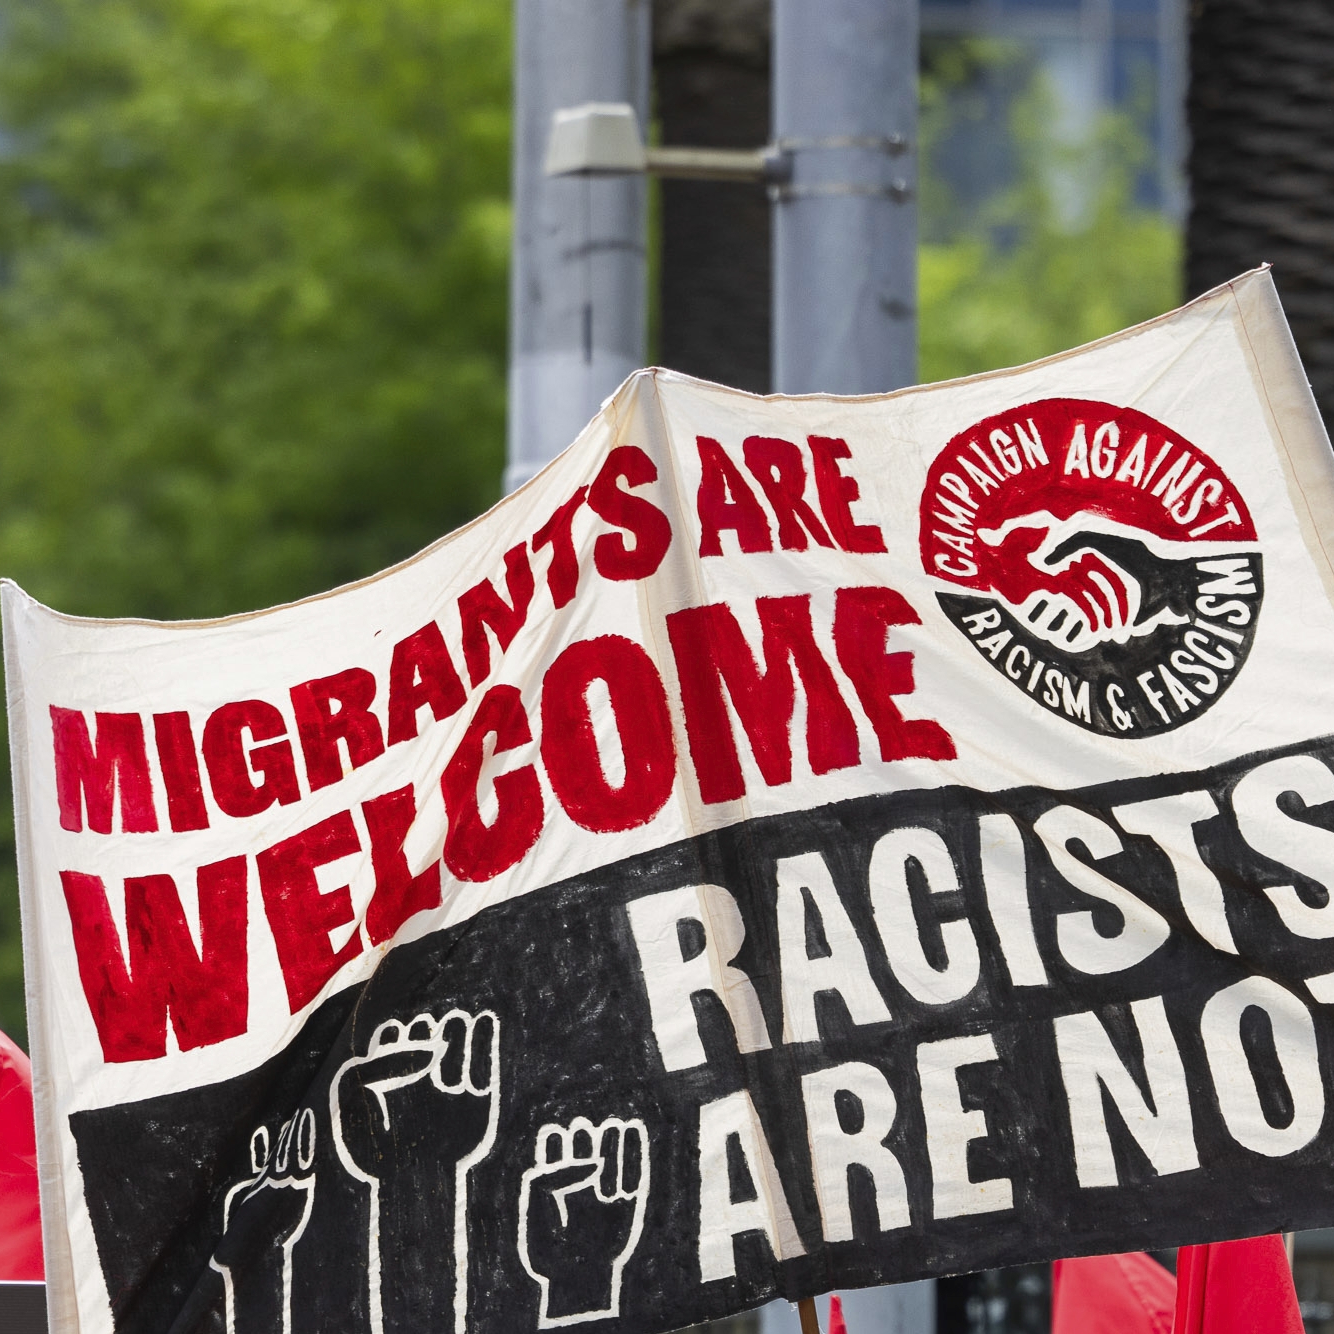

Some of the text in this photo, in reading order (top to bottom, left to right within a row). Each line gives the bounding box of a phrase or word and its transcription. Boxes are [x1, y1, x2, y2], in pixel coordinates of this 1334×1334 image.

[933, 418, 1243, 577] CAMPAIGN AGAINST
[49, 434, 887, 836] MIGRANTS ARE
[962, 558, 1258, 731] RACISM & FASCISM
[60, 585, 957, 1064] WELCOME
[697, 1034, 1014, 1285] ARE
